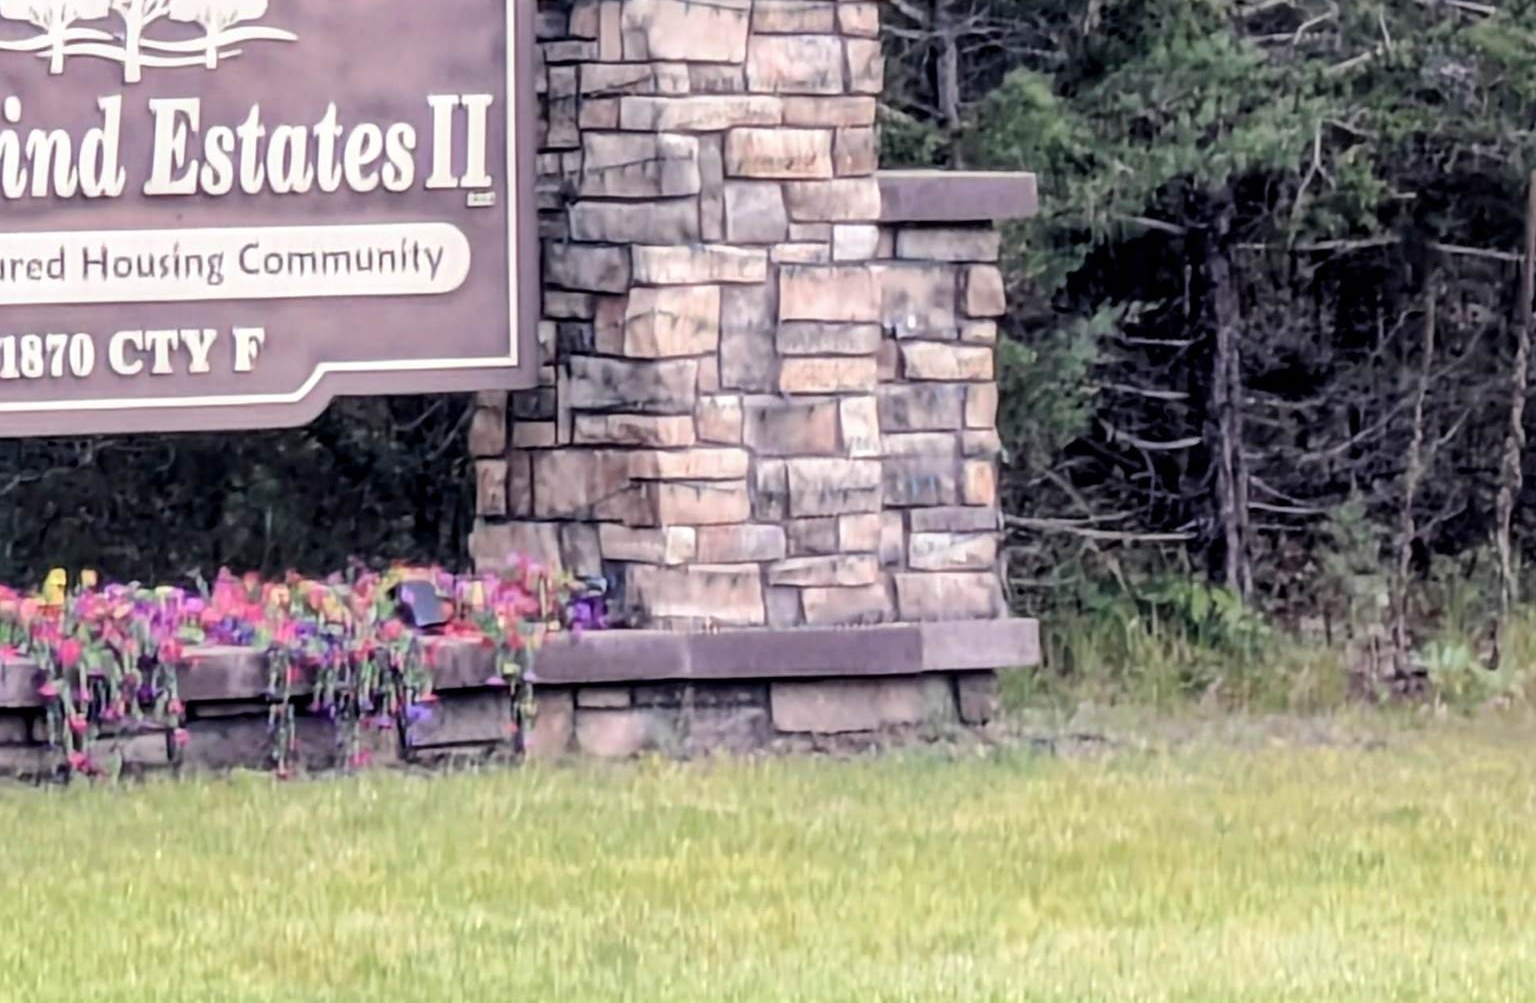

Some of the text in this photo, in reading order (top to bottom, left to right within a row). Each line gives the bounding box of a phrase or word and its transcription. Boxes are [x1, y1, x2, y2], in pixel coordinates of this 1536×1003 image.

[142, 97, 416, 196] Estates
[425, 93, 494, 188] II
[81, 245, 225, 287] Housing
[237, 237, 445, 281] Community
[107, 327, 219, 376] CTY
[231, 326, 266, 372] F
